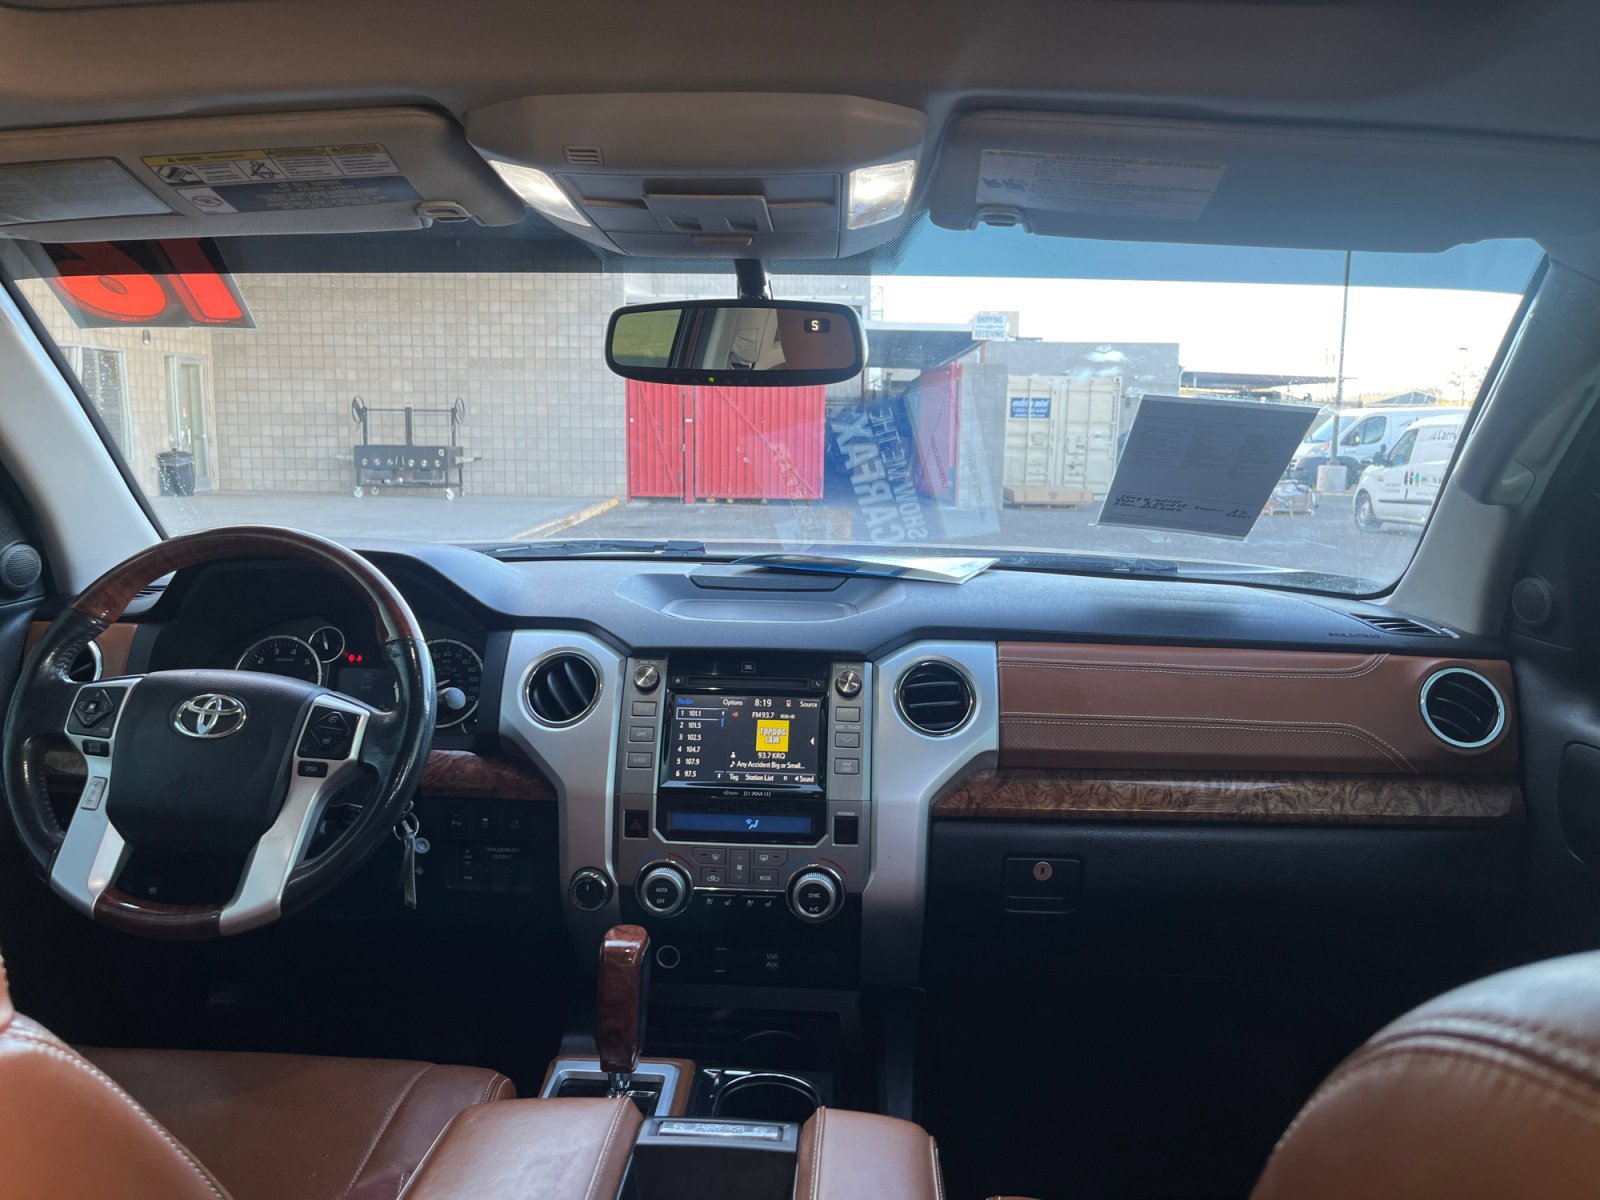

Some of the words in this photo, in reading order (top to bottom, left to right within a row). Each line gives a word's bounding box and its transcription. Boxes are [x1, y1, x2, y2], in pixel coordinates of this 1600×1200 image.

[811, 320, 820, 330] S
[760, 728, 787, 736] TOPDOG
[766, 736, 780, 744] LAW
